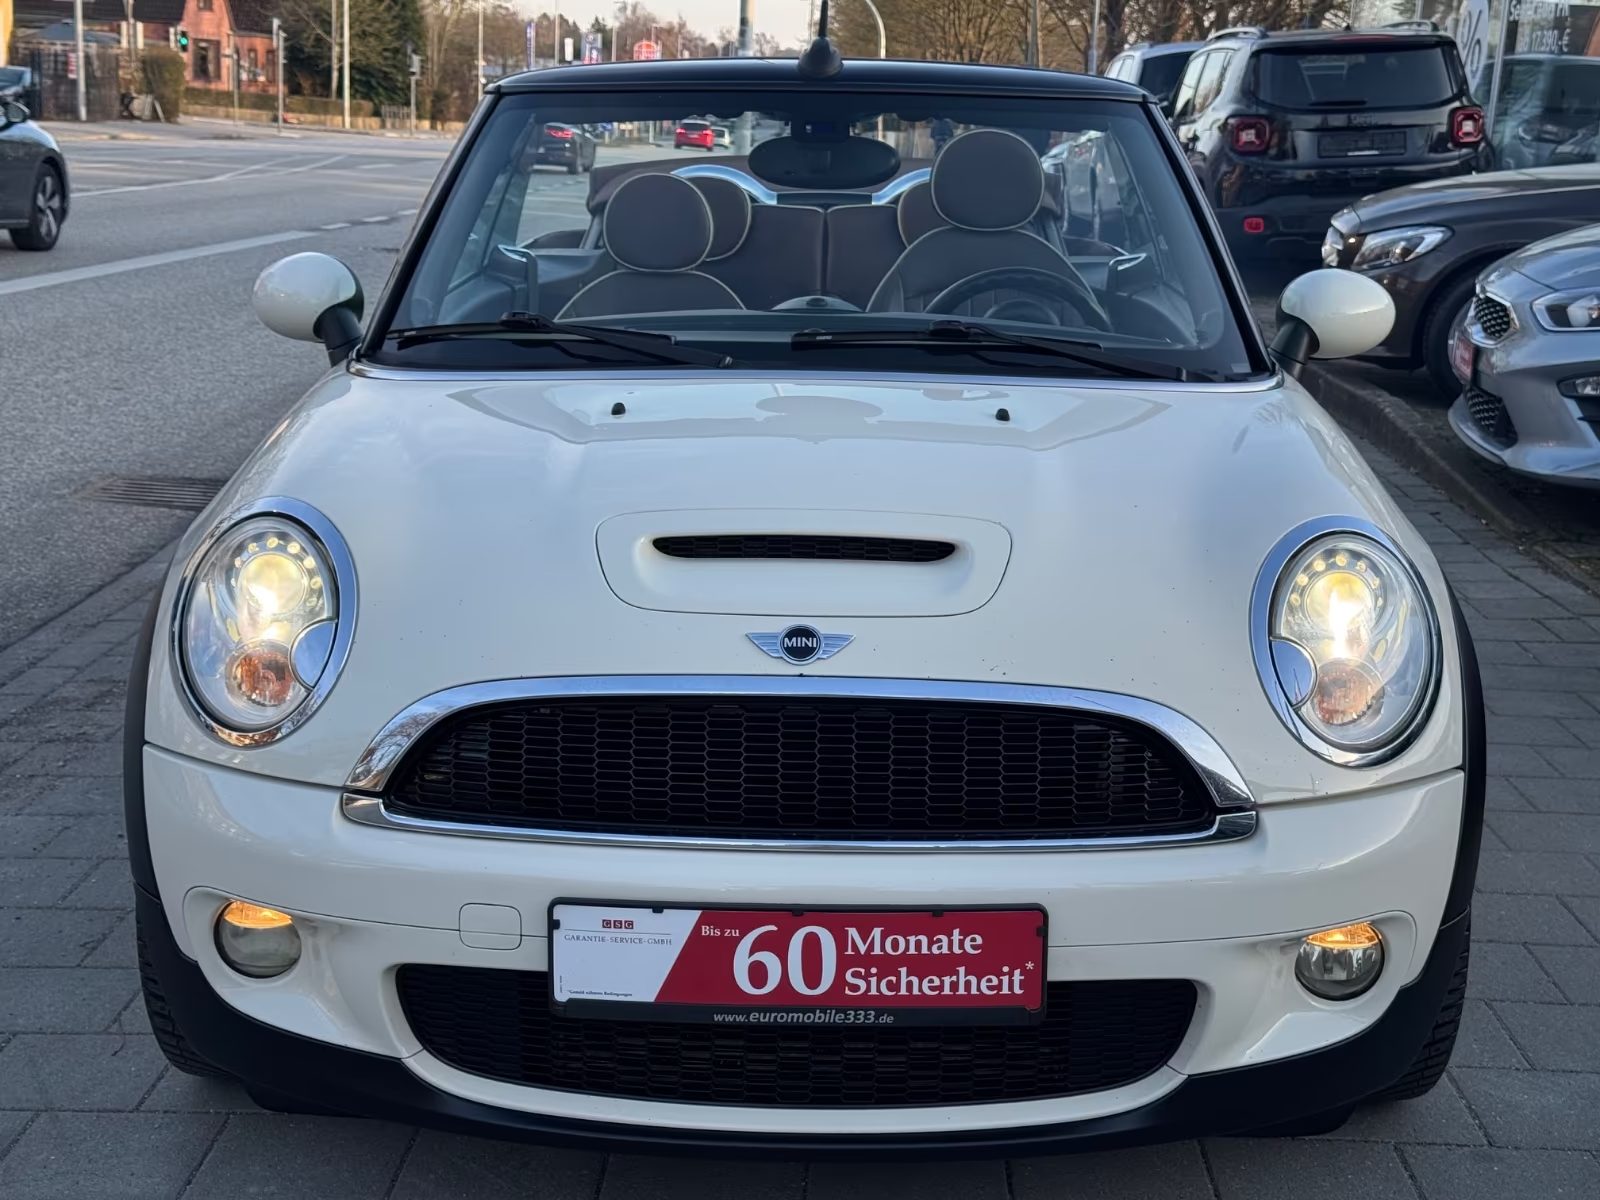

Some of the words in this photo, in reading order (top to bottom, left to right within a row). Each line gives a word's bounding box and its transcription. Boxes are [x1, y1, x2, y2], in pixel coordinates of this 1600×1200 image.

[784, 637, 817, 648] MINI
[602, 919, 634, 930] GSG
[701, 925, 721, 937] Bis
[724, 929, 740, 937] zu
[564, 934, 673, 946] GARANTIE-SERVICE-GMBH
[844, 927, 983, 955] Monate
[733, 924, 837, 996] 60
[713, 1010, 894, 1025] www.euromobile333.de
